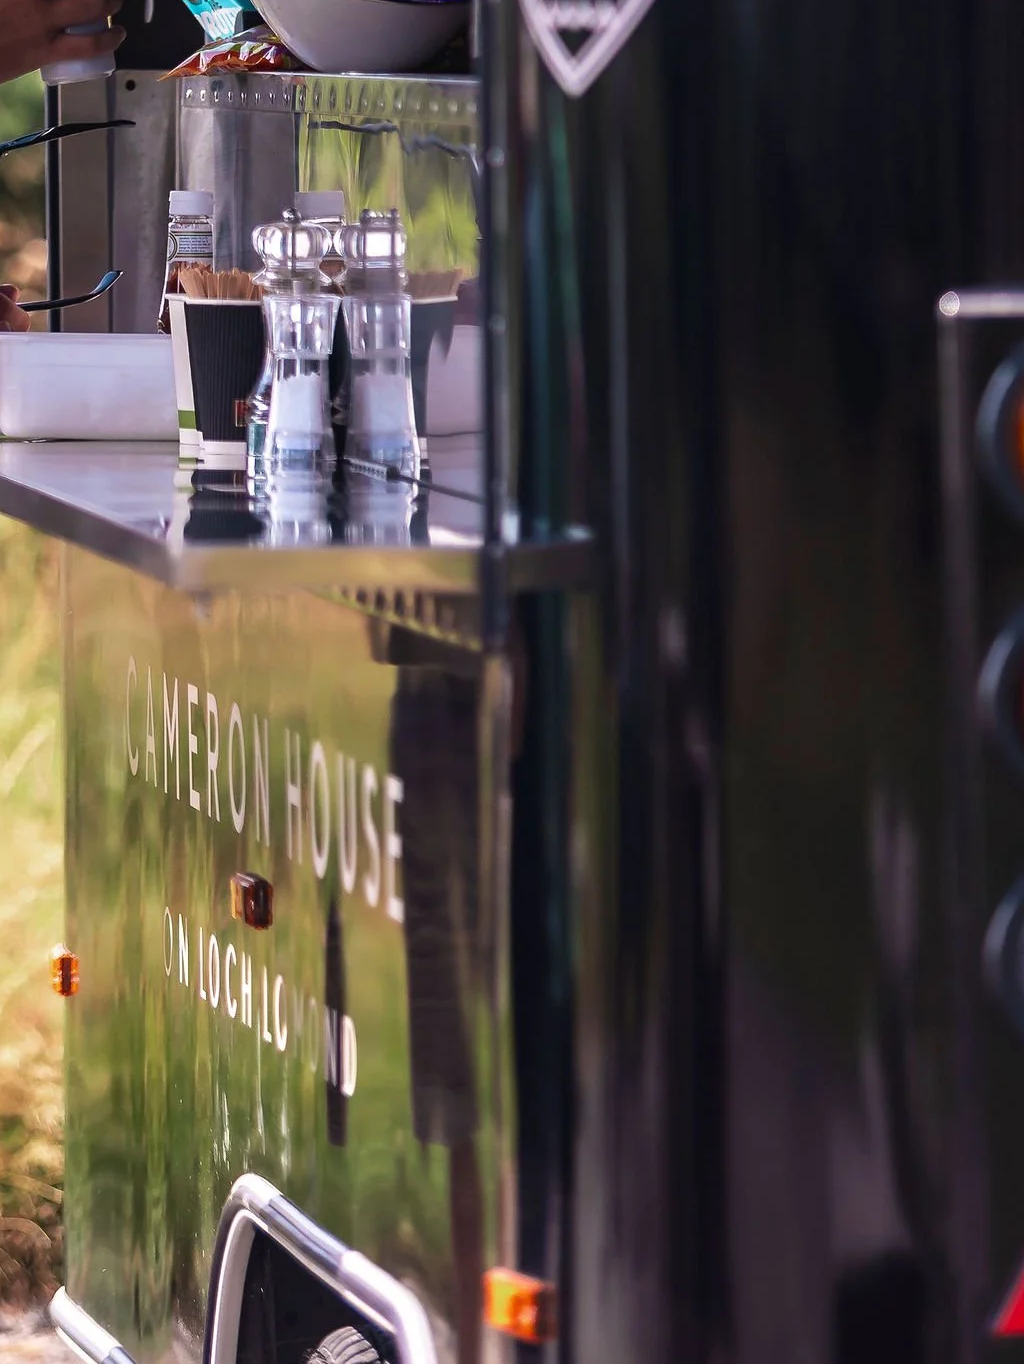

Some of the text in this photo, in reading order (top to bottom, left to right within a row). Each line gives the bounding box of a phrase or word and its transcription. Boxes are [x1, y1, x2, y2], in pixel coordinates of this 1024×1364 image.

[126, 655, 404, 923] CAMERON HOUSE
[163, 907, 189, 987] ON
[199, 927, 253, 1028] LOCH
